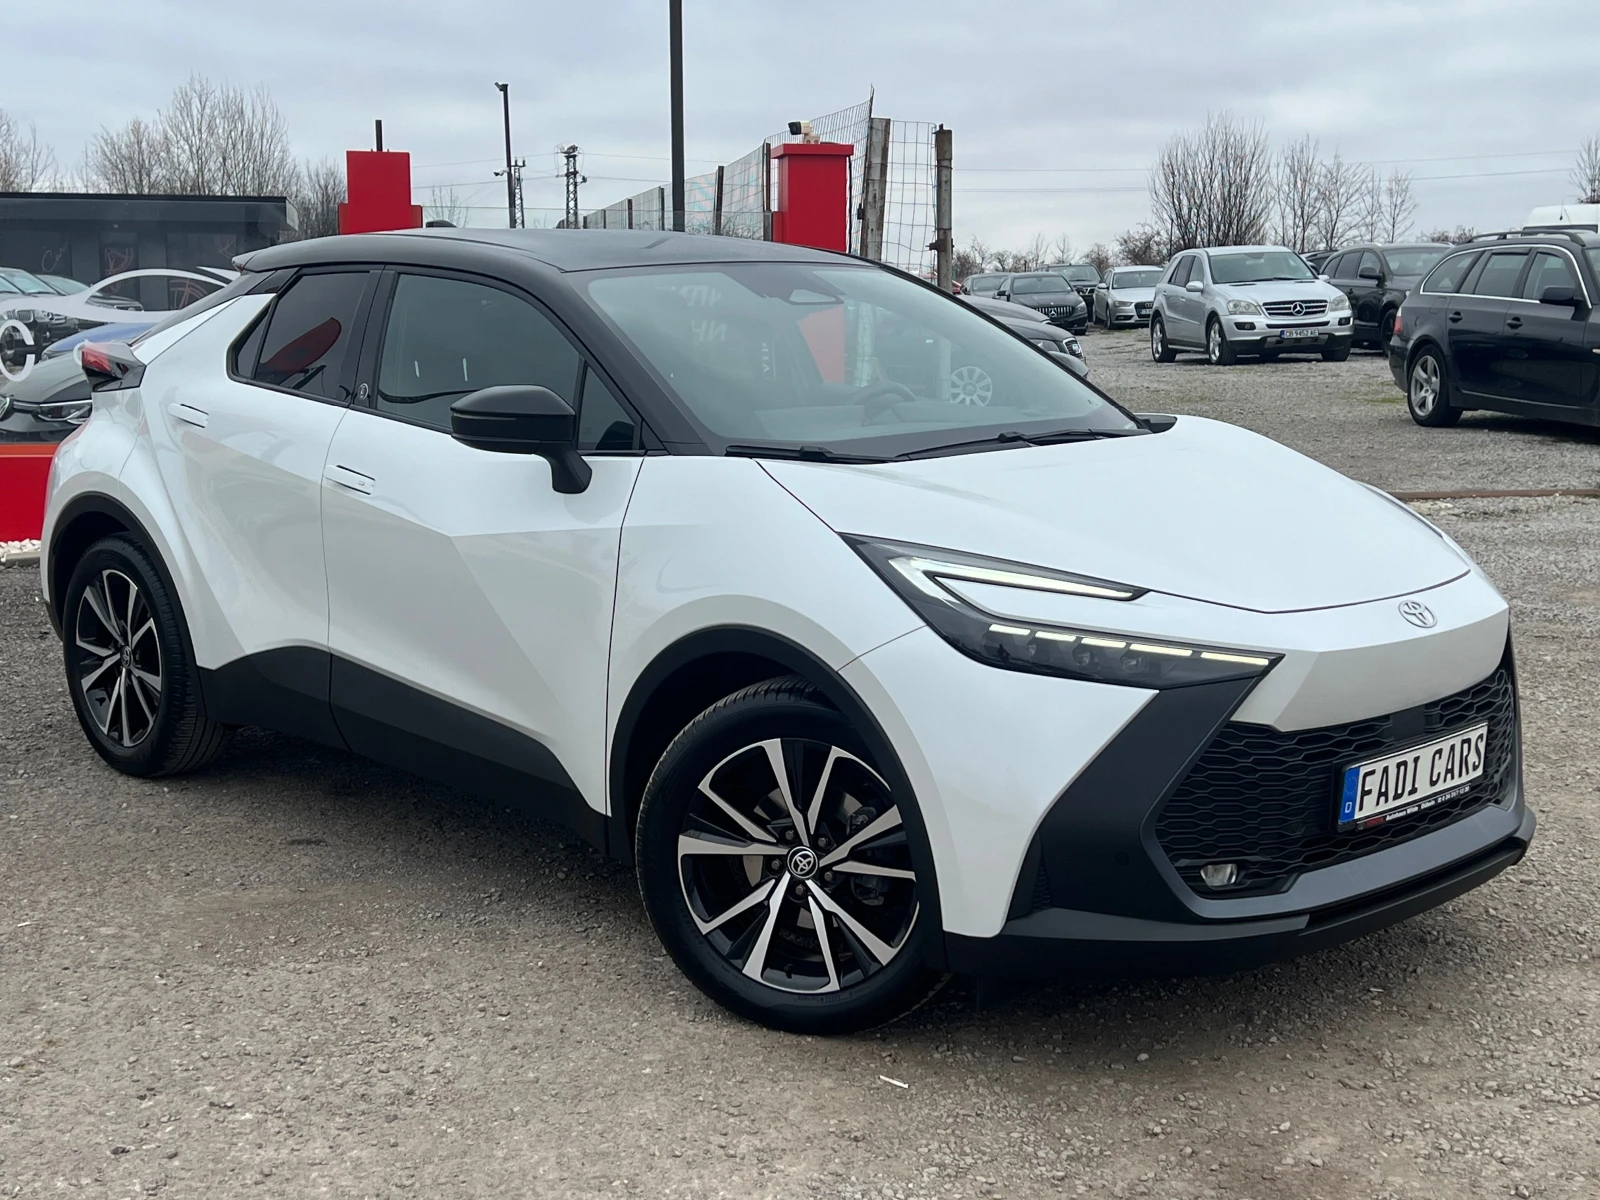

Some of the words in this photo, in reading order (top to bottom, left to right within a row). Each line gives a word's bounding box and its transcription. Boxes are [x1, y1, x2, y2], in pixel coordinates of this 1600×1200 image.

[1359, 755, 1420, 812] FADI
[1430, 732, 1484, 787] CARS
[1345, 802, 1352, 813] D
